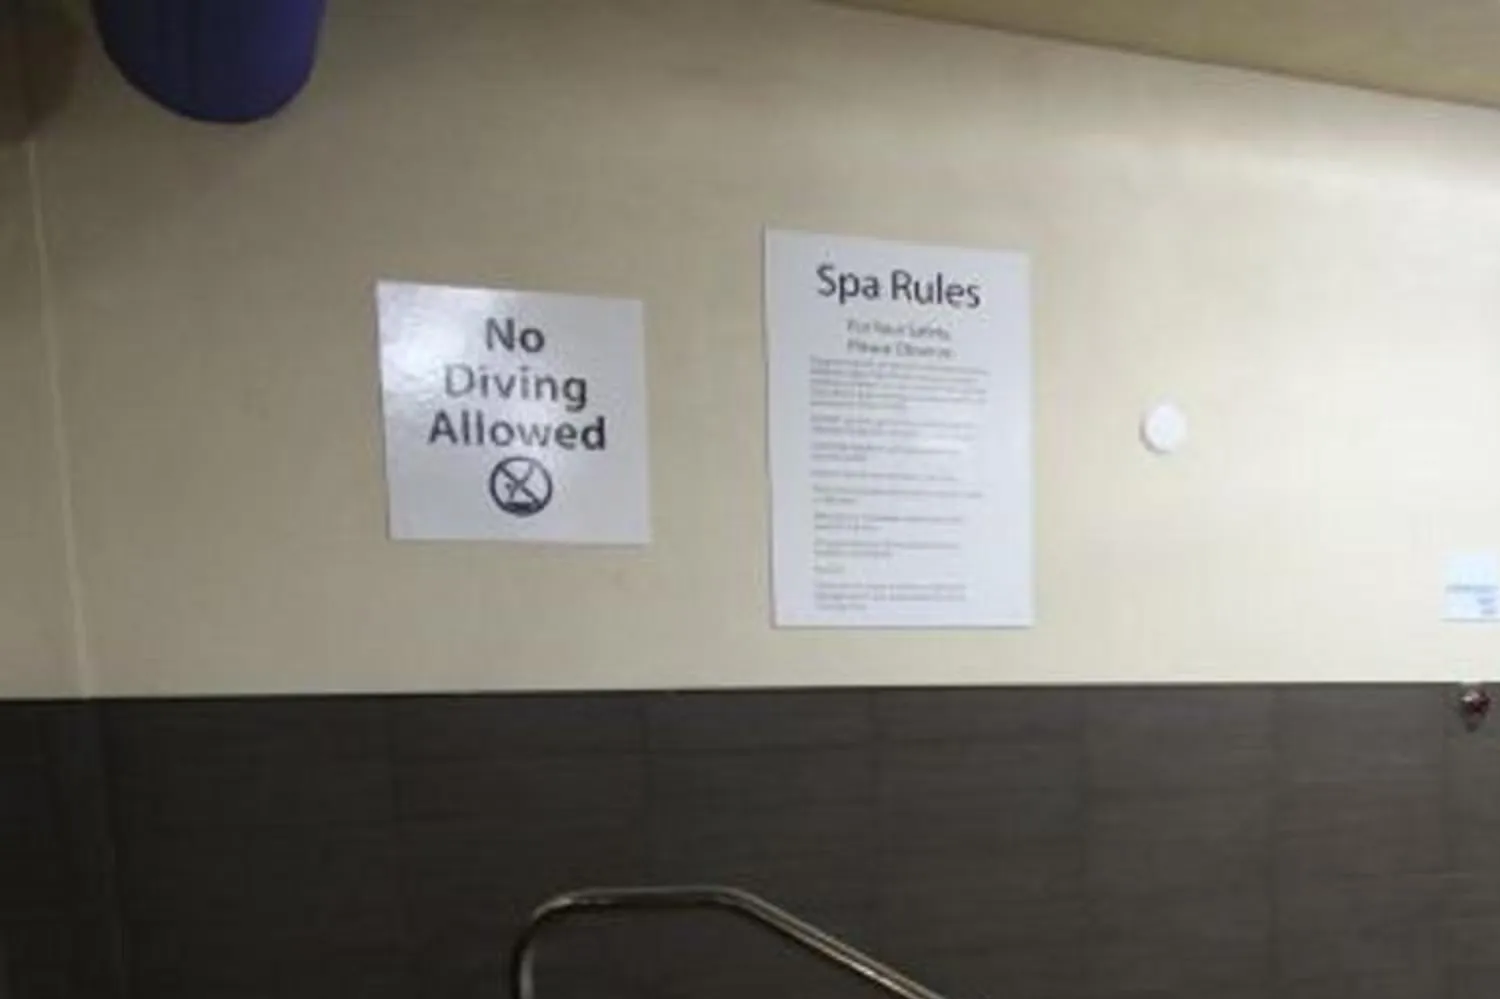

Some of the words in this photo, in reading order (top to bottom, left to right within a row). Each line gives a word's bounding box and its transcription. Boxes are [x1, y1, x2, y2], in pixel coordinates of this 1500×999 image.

[816, 263, 880, 305] Spa
[891, 269, 982, 309] Rules
[486, 317, 546, 353] No
[445, 363, 588, 413] Diving
[427, 408, 607, 451] Allowed
